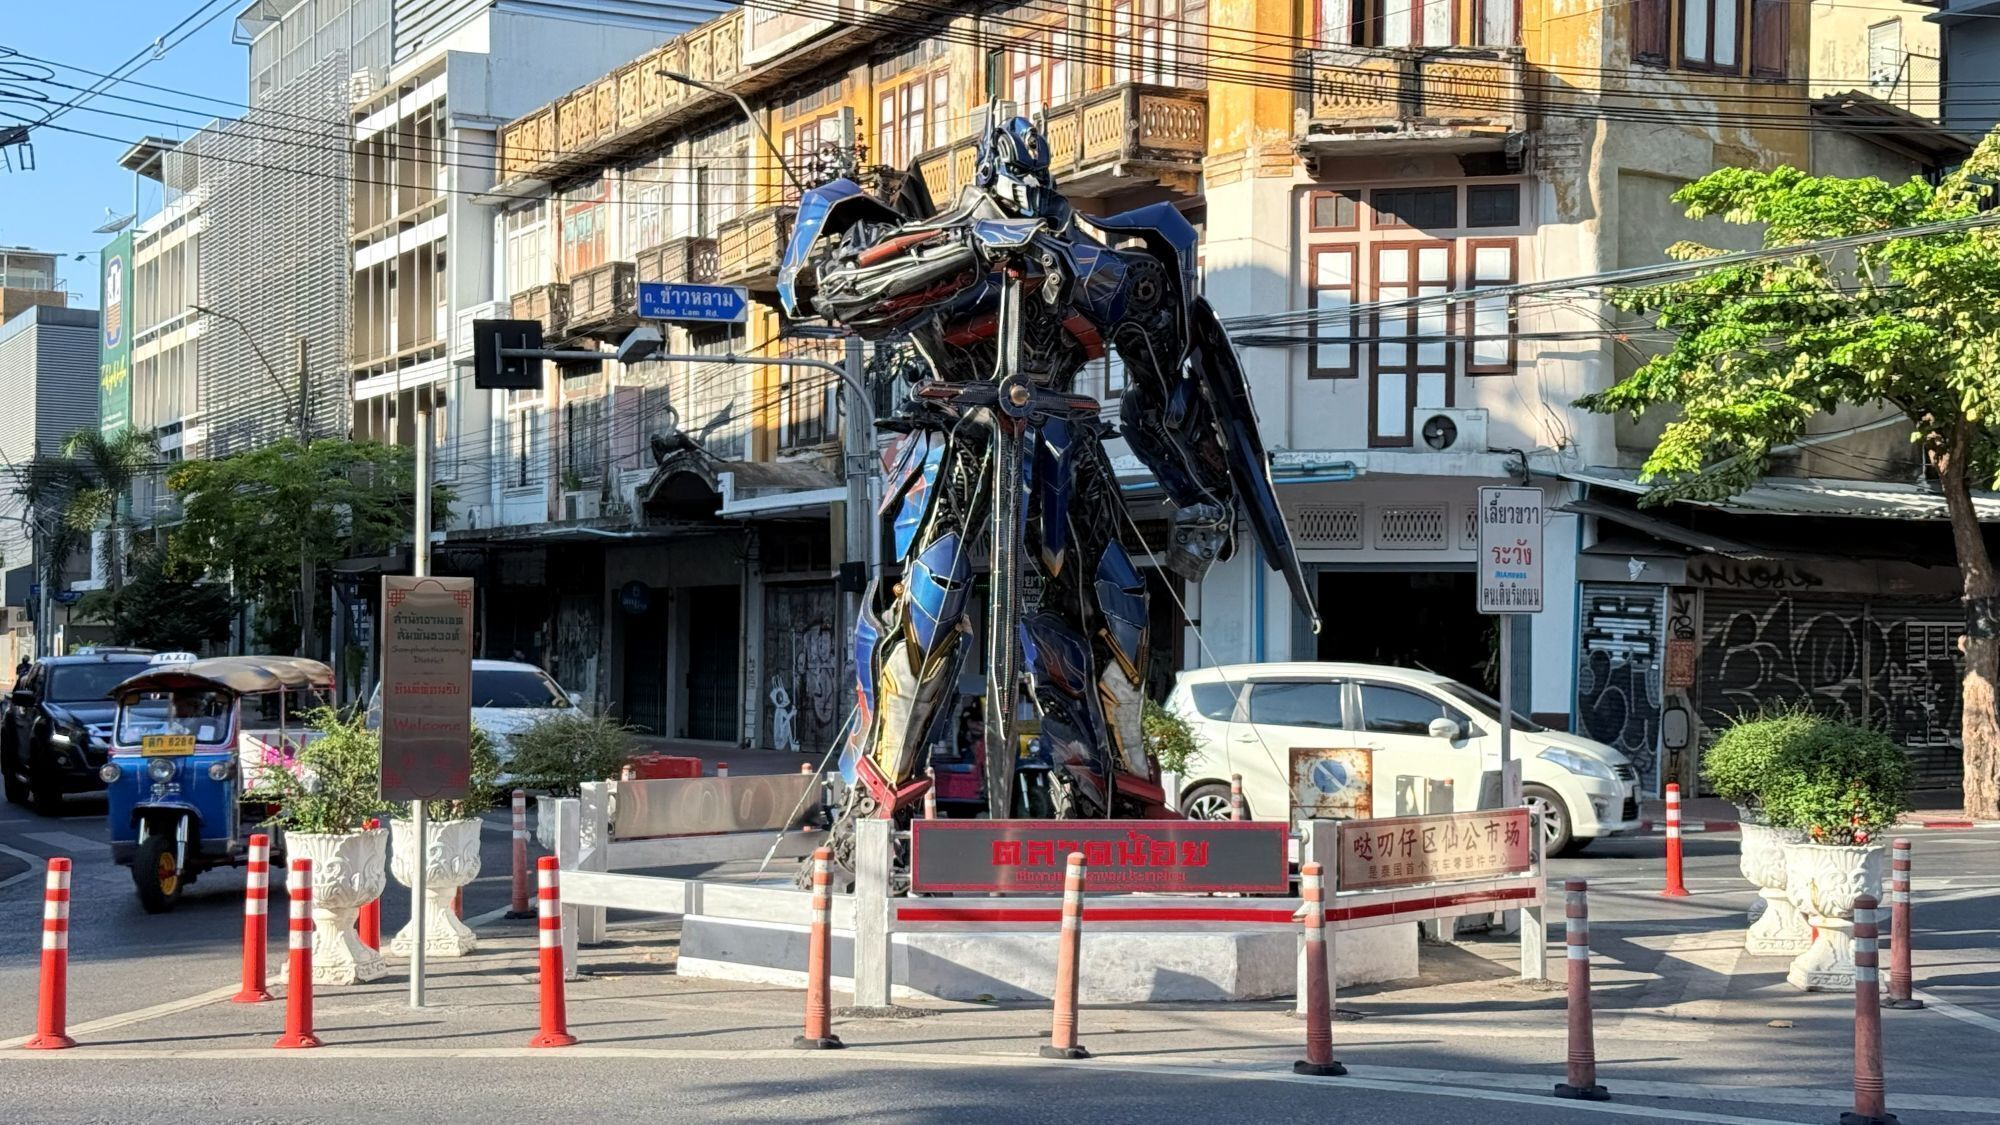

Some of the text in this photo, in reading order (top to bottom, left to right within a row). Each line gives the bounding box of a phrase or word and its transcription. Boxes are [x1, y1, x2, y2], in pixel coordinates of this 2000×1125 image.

[644, 285, 734, 307] ถ. ข้าวหลาม
[653, 307, 719, 317] Khao Lam Rd.
[1484, 491, 1539, 524] เลี้ยวขวา
[1491, 539, 1532, 565] ระวัง
[1484, 582, 1539, 606] คนเดินริมถนน
[393, 611, 464, 625] สำนักงานเขต
[396, 627, 460, 641] สัมพันธวงศ์
[395, 681, 460, 695] ยินดีต้อนรับ
[393, 717, 461, 731] Welcome
[991, 830, 1209, 867] ตลาดน้อย
[1353, 820, 1521, 862] 哒叻仔区仙公市场
